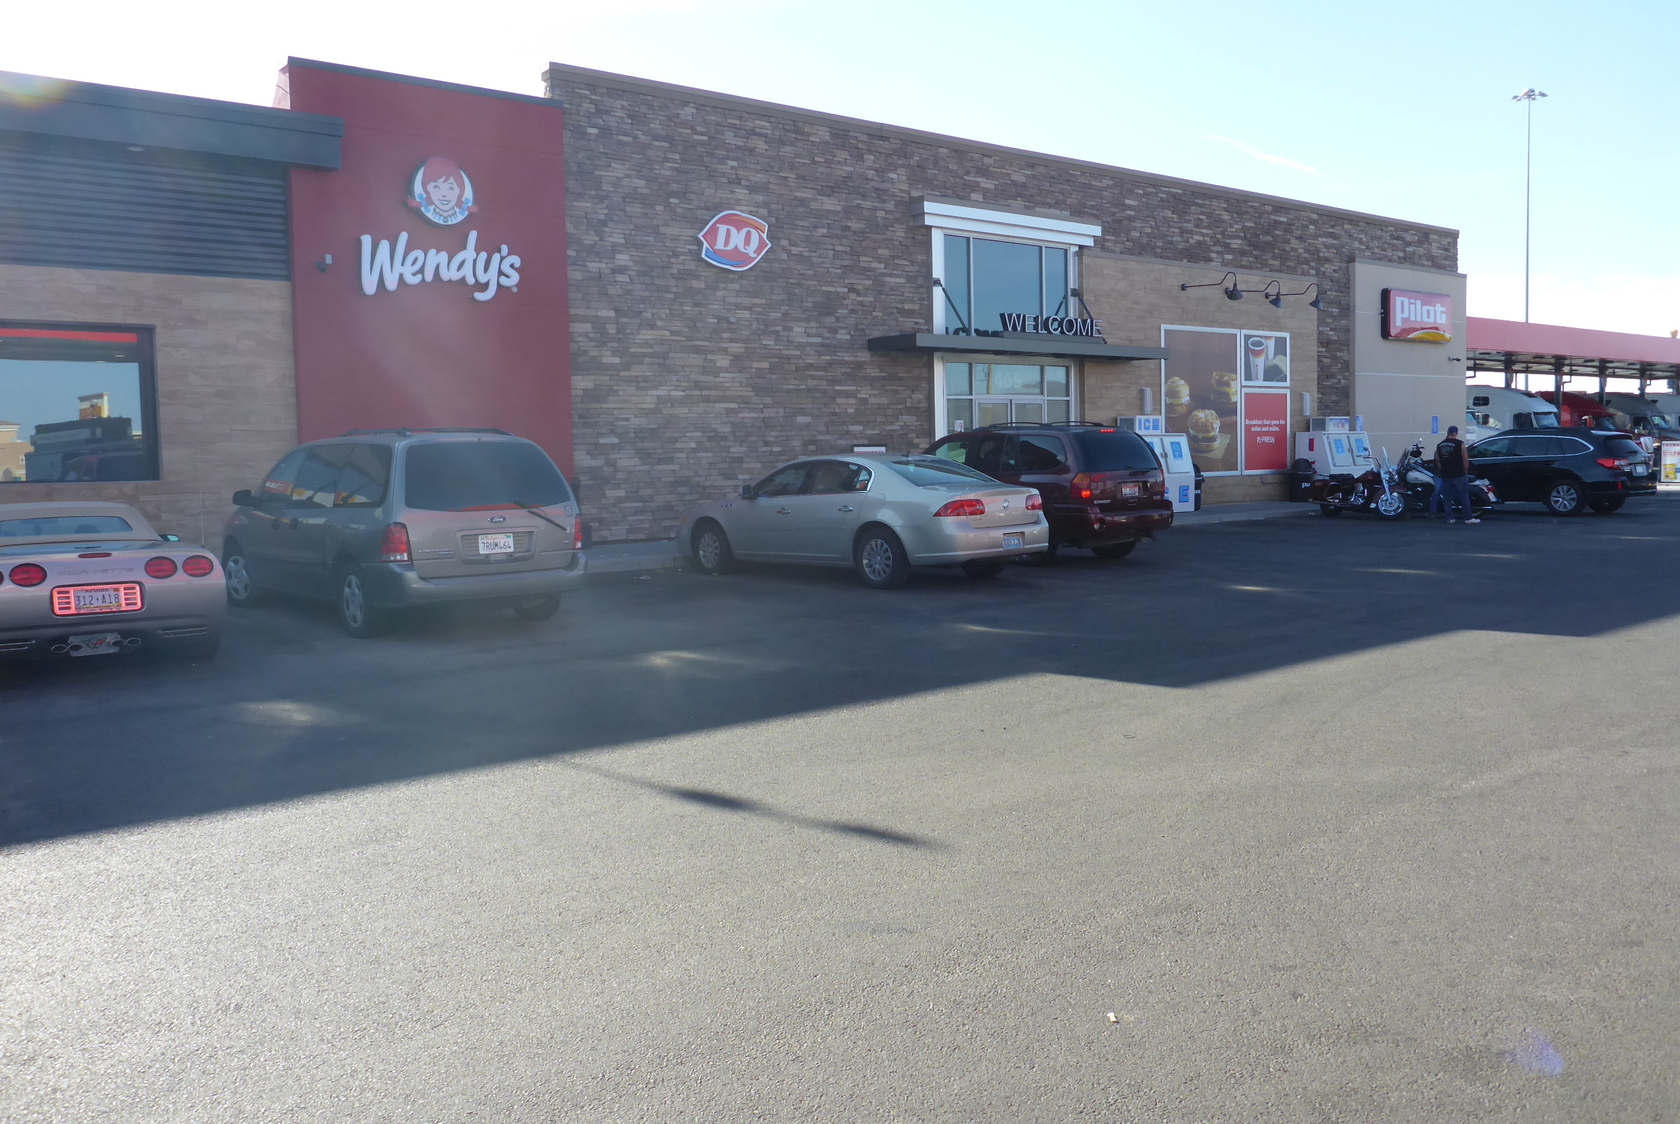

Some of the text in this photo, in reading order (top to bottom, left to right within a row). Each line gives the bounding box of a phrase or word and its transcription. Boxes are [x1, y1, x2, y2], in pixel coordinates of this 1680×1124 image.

[714, 224, 760, 258] DQ
[360, 230, 522, 302] Wendy's
[1395, 296, 1447, 327] Pilot
[1003, 312, 1104, 338] WELCOME
[993, 371, 1022, 389] 465
[1137, 418, 1160, 431] ICE
[481, 541, 512, 552] 7RUM464
